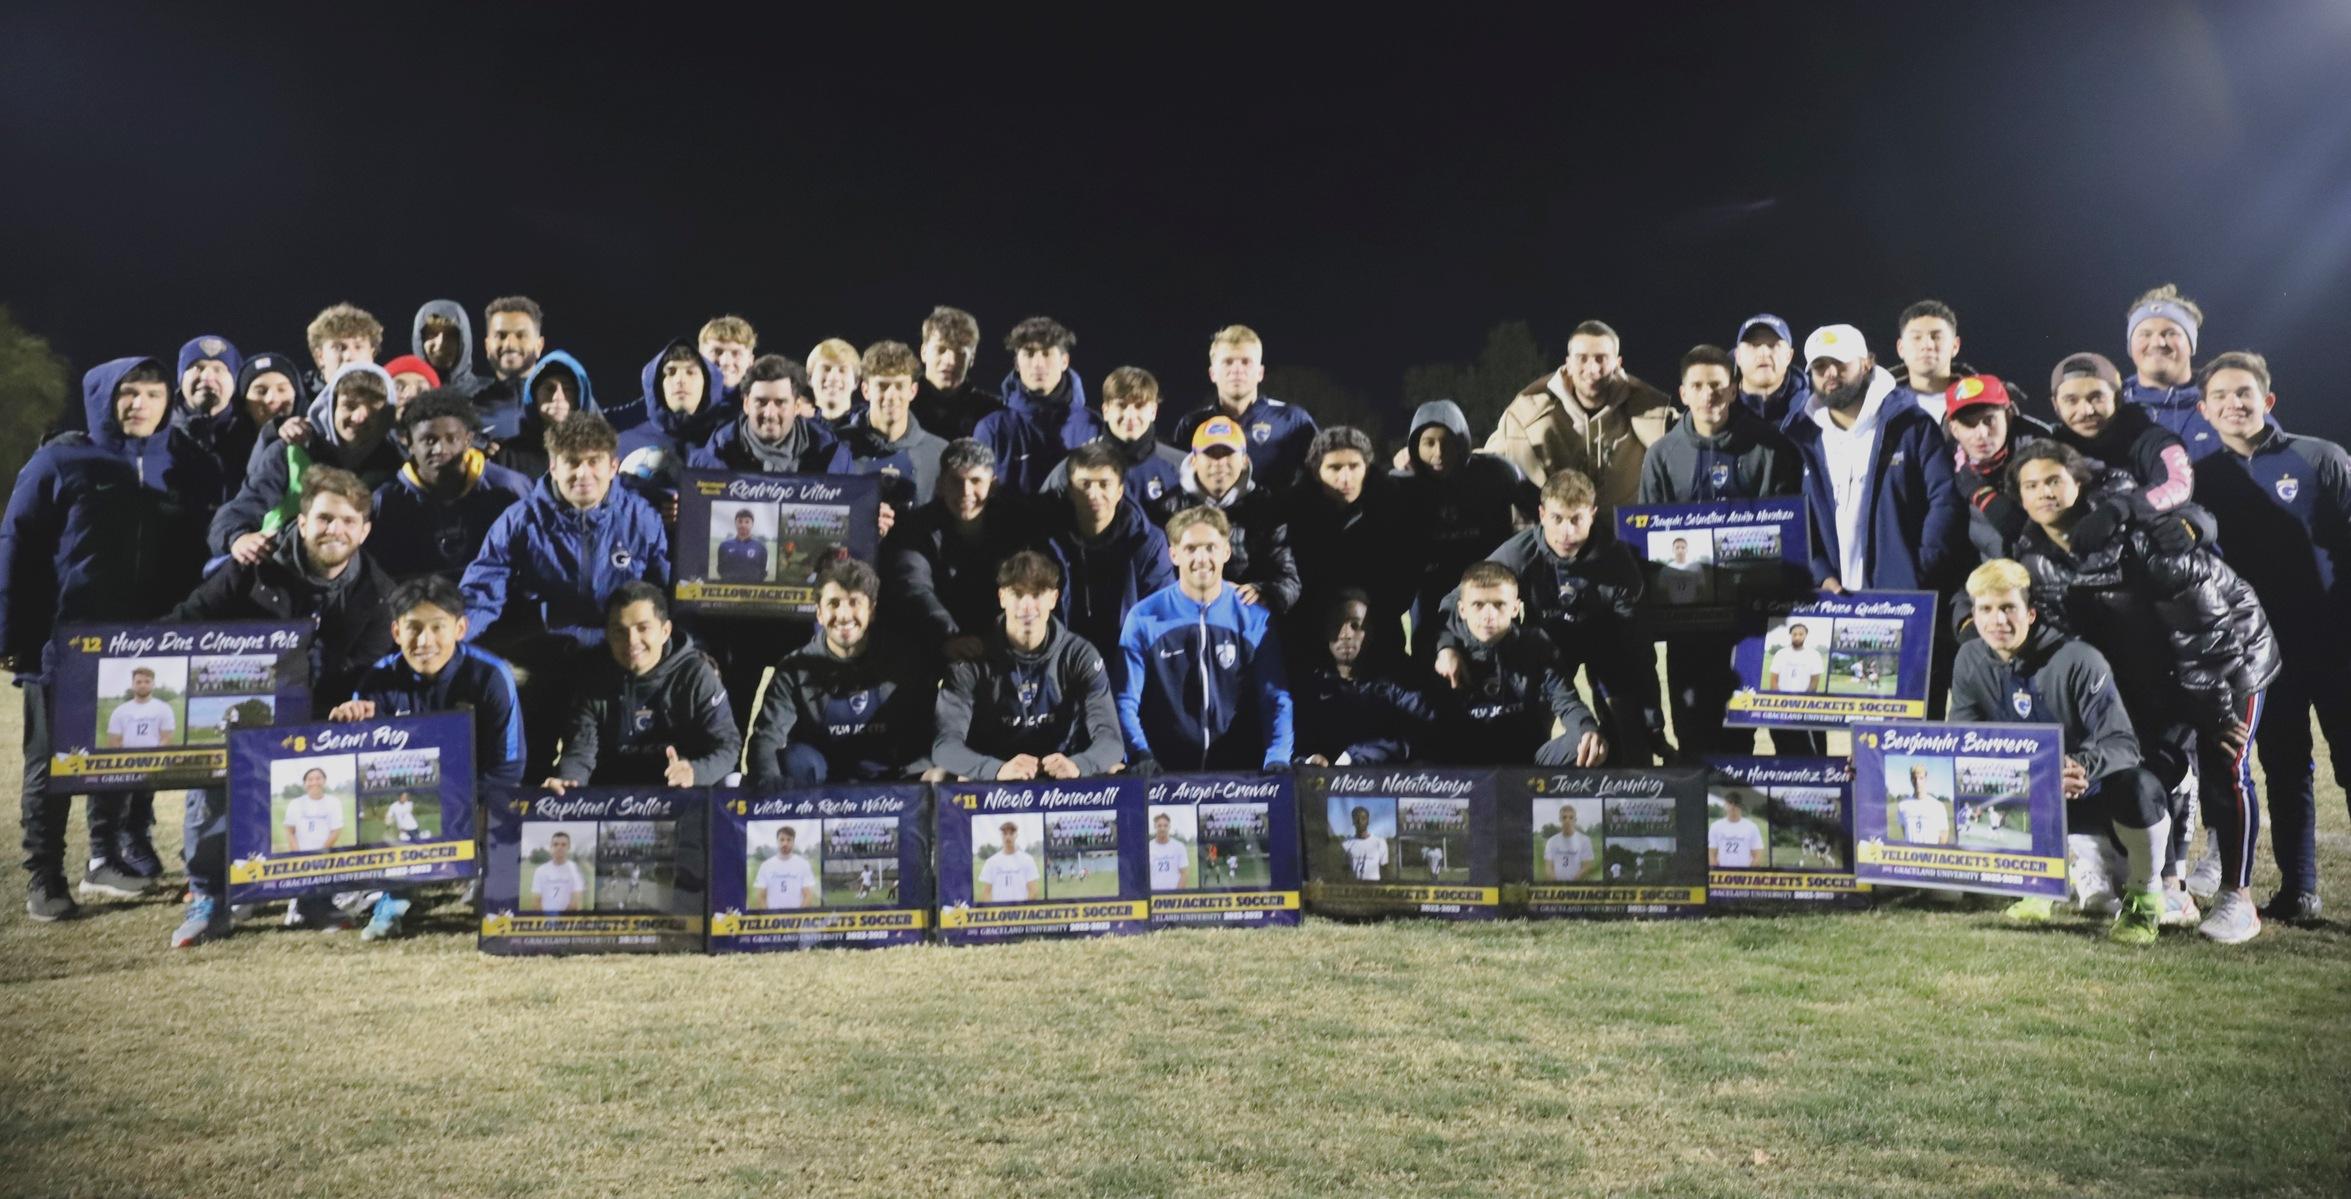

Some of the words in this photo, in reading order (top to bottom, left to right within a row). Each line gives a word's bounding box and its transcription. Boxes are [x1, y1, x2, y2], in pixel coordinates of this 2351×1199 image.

[728, 480, 794, 504] Rodrigo
[800, 482, 842, 501] Vilar
[701, 587, 806, 600] YELLOWJACKETS
[69, 635, 103, 654] #12
[108, 631, 155, 657] Hugo
[158, 631, 194, 651] Das
[199, 631, 265, 655] Chagas
[1752, 697, 1854, 711] YELLOWJACKETS
[1858, 702, 1908, 713] SOCCER
[312, 729, 368, 752] Sean
[1881, 729, 1959, 755] Benjamin
[1961, 731, 2039, 754] Barrera
[85, 753, 224, 770] YELLOWJACKETS
[101, 773, 146, 784] GRACELA
[1528, 777, 1546, 793] #3
[1550, 774, 1593, 794] Jack
[952, 793, 977, 810] #11
[1039, 786, 1120, 810] Monacelli
[1170, 781, 1280, 806] Angel-Craven
[535, 796, 615, 821] Raphael
[616, 795, 672, 817] Salles
[795, 799, 814, 815] da
[263, 851, 396, 876] YELLOWJACKETS
[400, 845, 457, 862] SOCCER
[1881, 850, 1990, 868] YELLOWJACKETS
[1993, 858, 2048, 873] SOCCER
[1710, 875, 1803, 888] LLOWJACKETS
[1152, 896, 1232, 909] OWJACKETS
[1235, 895, 1285, 908] SOCCER
[738, 916, 856, 931] YELLOWJACKETS
[859, 913, 912, 928] SOCCER
[965, 908, 1078, 923] YELLOWJACKETS
[1082, 905, 1133, 918] SOCCER
